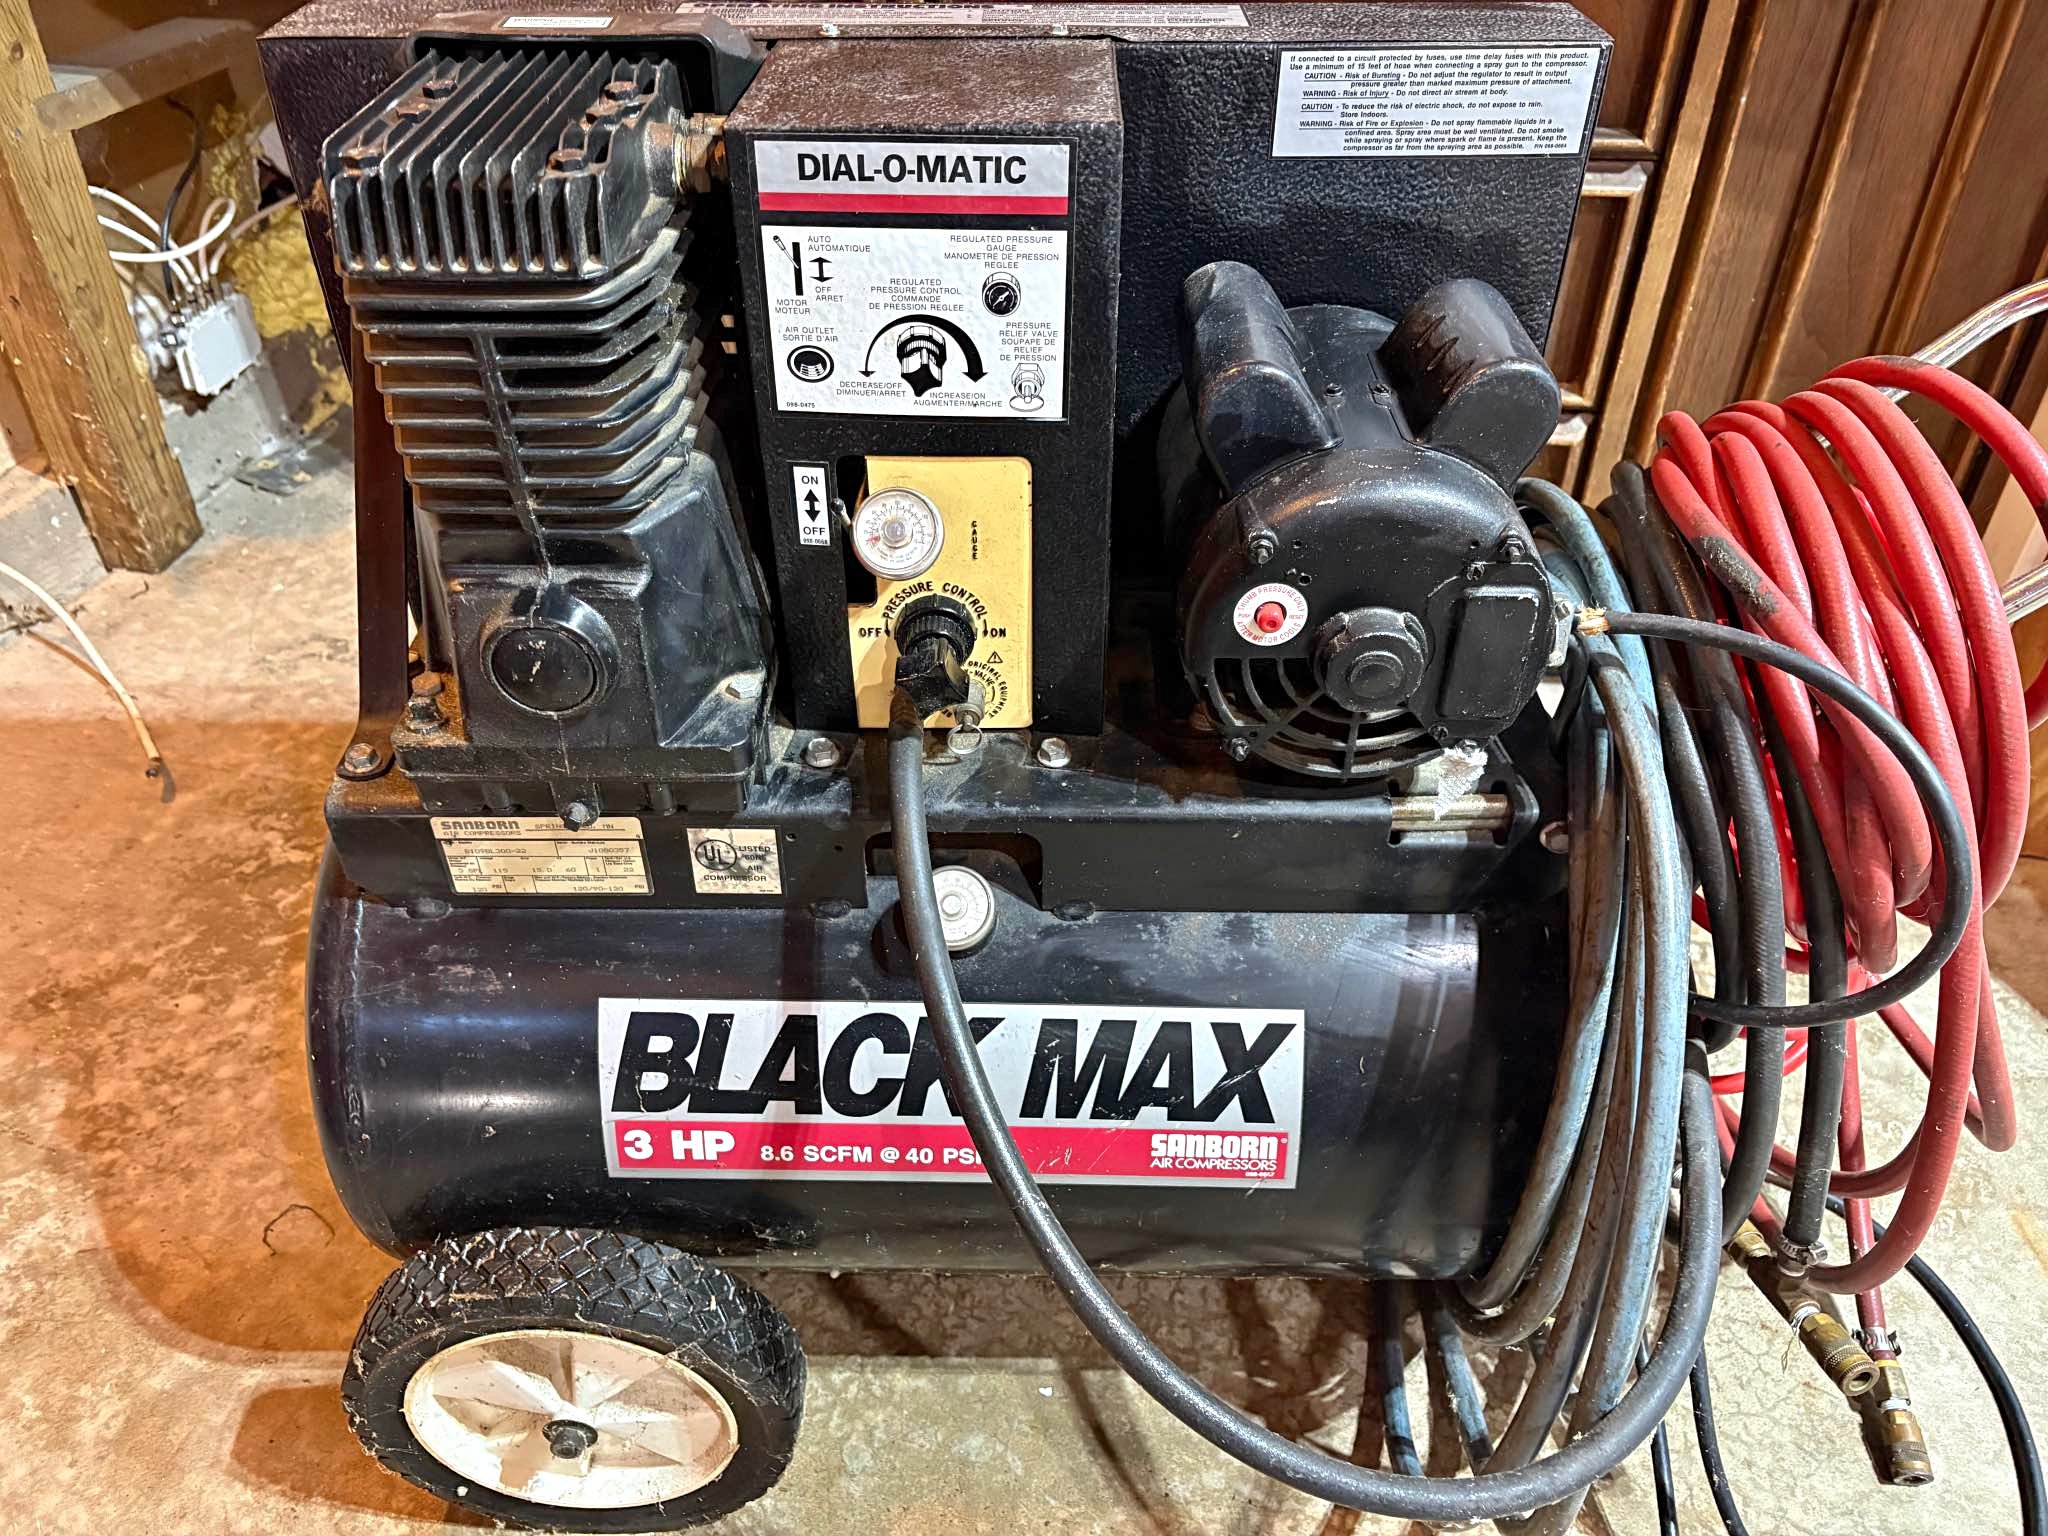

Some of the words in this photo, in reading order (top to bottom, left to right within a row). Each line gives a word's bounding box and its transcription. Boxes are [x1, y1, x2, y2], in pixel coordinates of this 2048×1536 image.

[1378, 55, 1412, 63] protected
[798, 153, 1026, 184] DIAL-O-MATIC
[836, 389, 906, 397] DIMINUER/ARRET
[840, 381, 902, 389] DECREASE/OFF
[801, 475, 818, 485] ON
[803, 526, 825, 535] OFF
[882, 581, 934, 619] PRESSURE
[943, 582, 987, 619] CONTROL
[1238, 592, 1257, 611] THUMB
[1258, 586, 1296, 598] PRESSURE
[1294, 596, 1305, 612] ONLY
[859, 628, 882, 637] OFF
[991, 628, 1006, 637] ON
[1237, 621, 1252, 638] AFTER
[1280, 623, 1301, 640] COOLS
[968, 661, 1001, 680] ORIGINAL
[989, 681, 1008, 718] EQUIPMENT
[441, 821, 520, 830] SANBORN
[704, 845, 730, 865] UL
[611, 1010, 1006, 1117] BLACK
[1019, 1018, 1298, 1124] MAX
[624, 1130, 653, 1160] 3
[671, 1130, 736, 1162] HP
[761, 1145, 794, 1162] 8.6
[803, 1146, 872, 1163] SCFM
[879, 1148, 900, 1164] @
[905, 1148, 934, 1164] 40
[1151, 1134, 1278, 1159] SANBORN
[1150, 1157, 1172, 1169] AIR
[1175, 1158, 1277, 1171] COMPRESSORS
